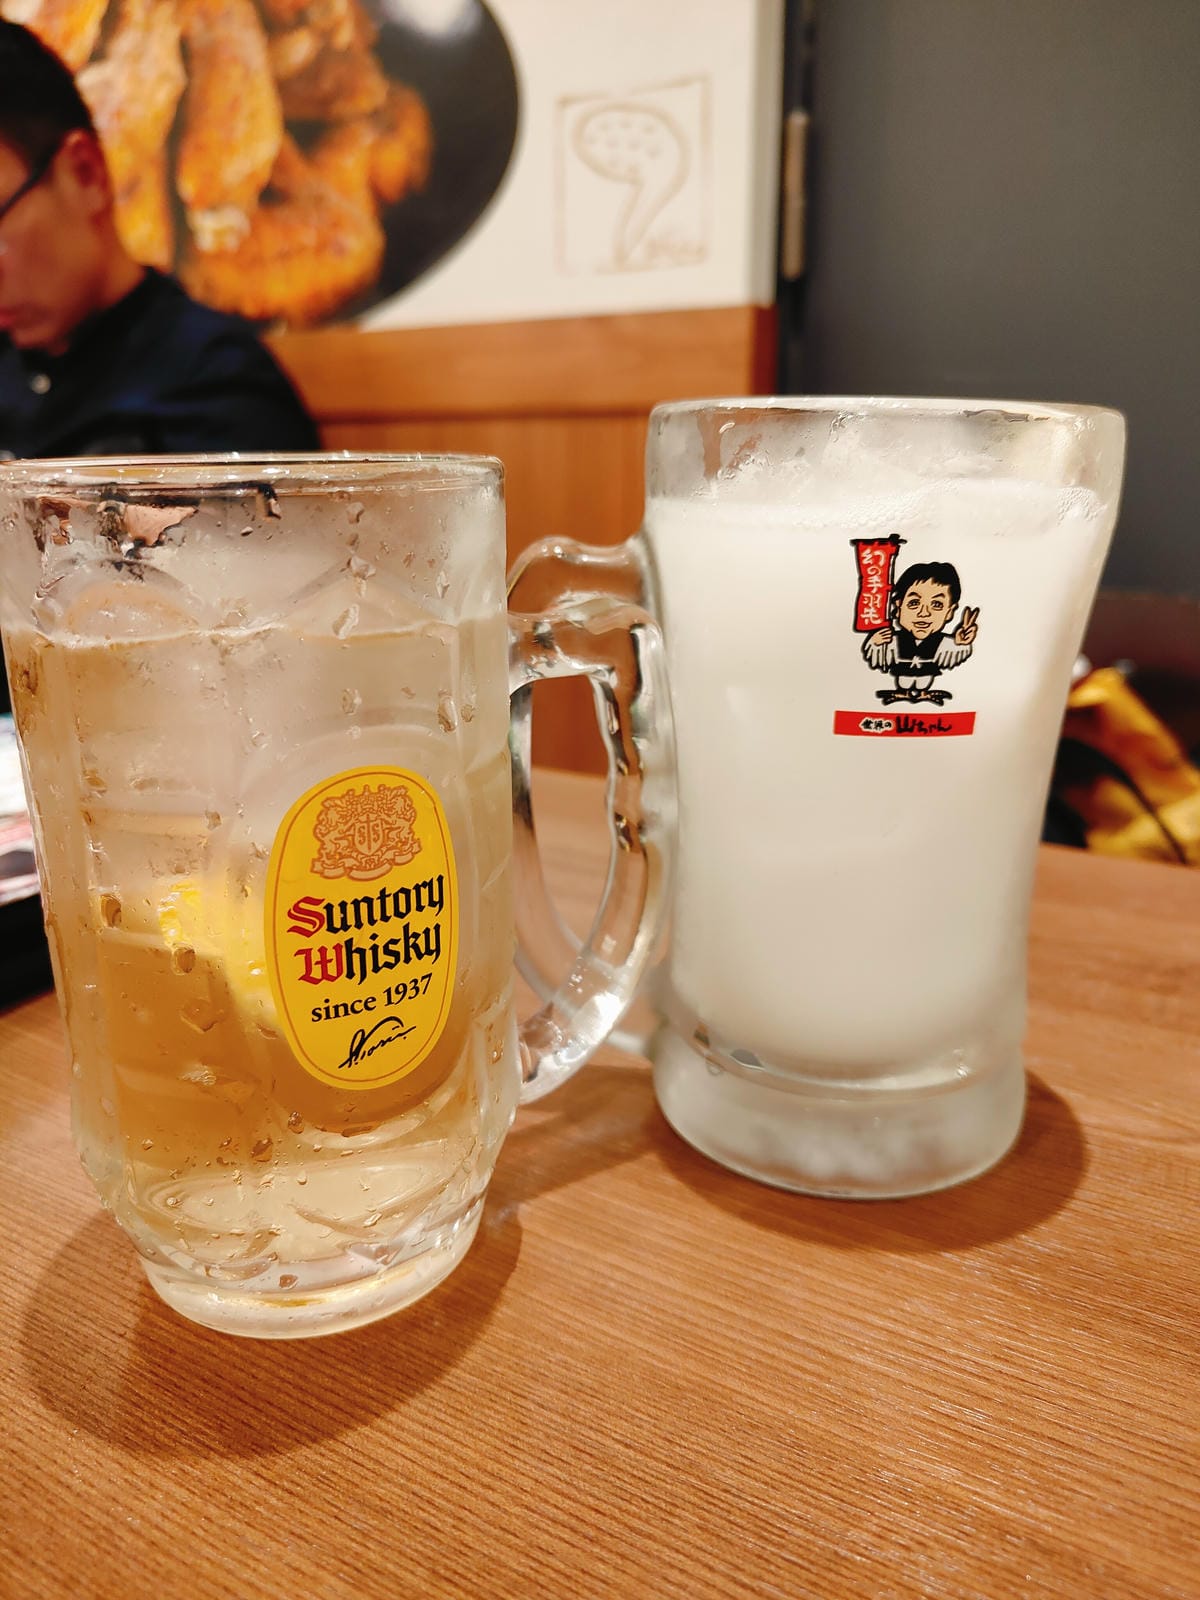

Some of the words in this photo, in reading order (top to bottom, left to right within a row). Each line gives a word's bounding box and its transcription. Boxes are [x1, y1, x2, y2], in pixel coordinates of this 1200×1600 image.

[861, 548, 885, 624] 幻の手羽先
[287, 874, 444, 938] Suntory
[294, 922, 441, 986] Whisky
[311, 994, 376, 1022] since
[383, 973, 432, 1007] 1937
